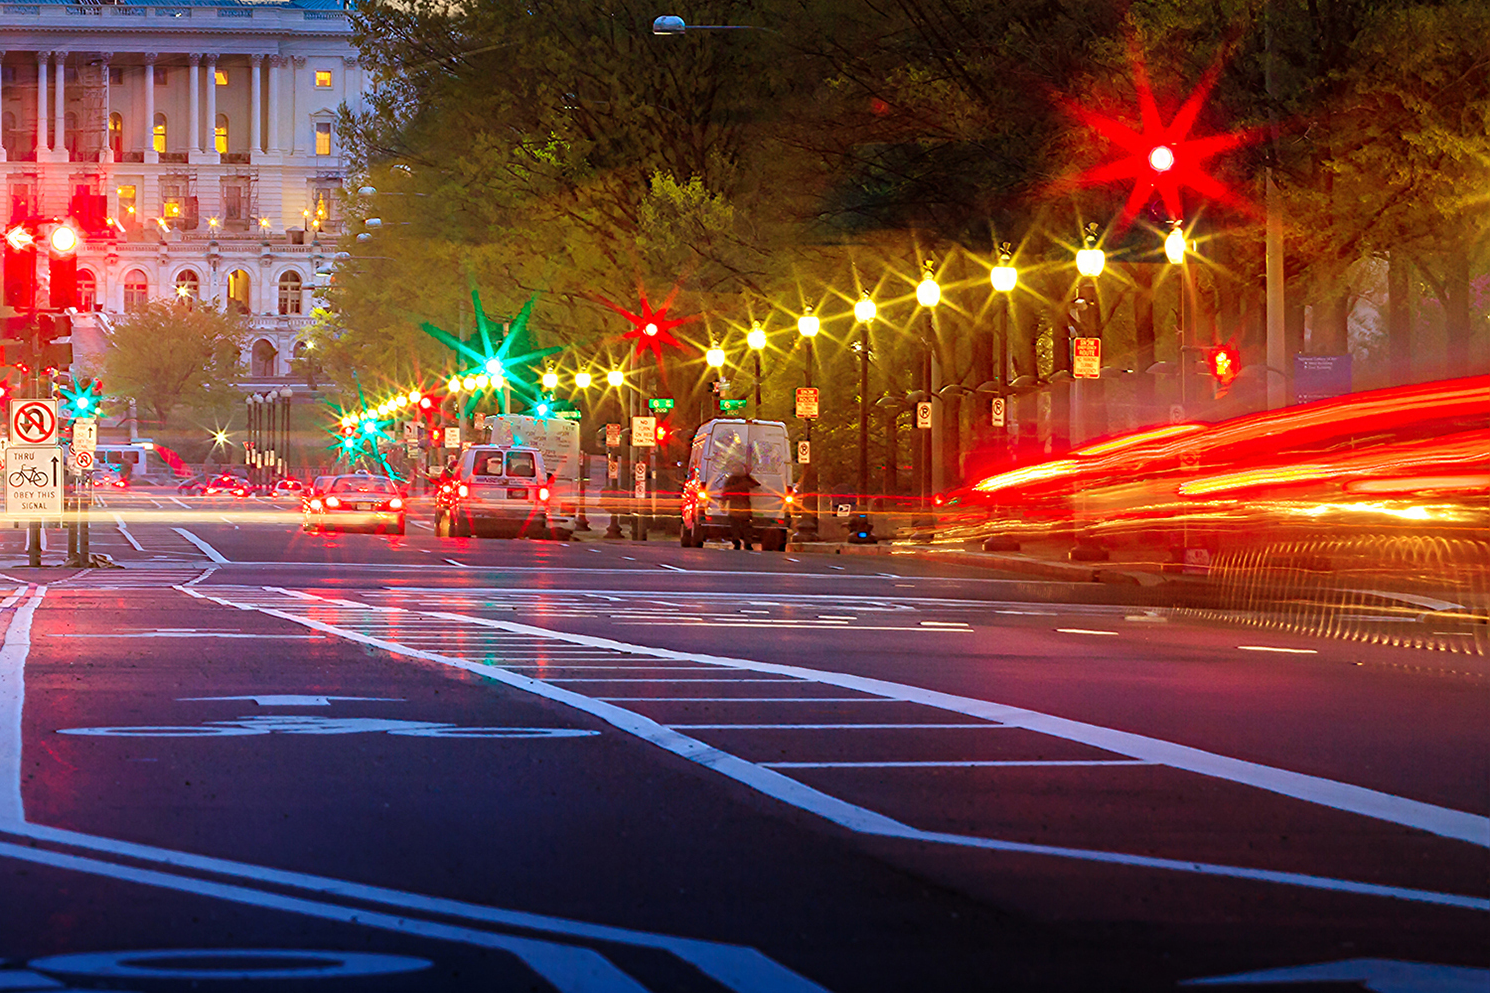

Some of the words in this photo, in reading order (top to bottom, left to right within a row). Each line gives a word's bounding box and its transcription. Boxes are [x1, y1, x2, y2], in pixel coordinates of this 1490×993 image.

[653, 399, 659, 407] 6
[724, 401, 731, 409] 6
[14, 452, 35, 460] THRU
[14, 491, 34, 499] OBEY
[37, 491, 56, 499] THIS
[21, 502, 47, 510] SIGNAL
